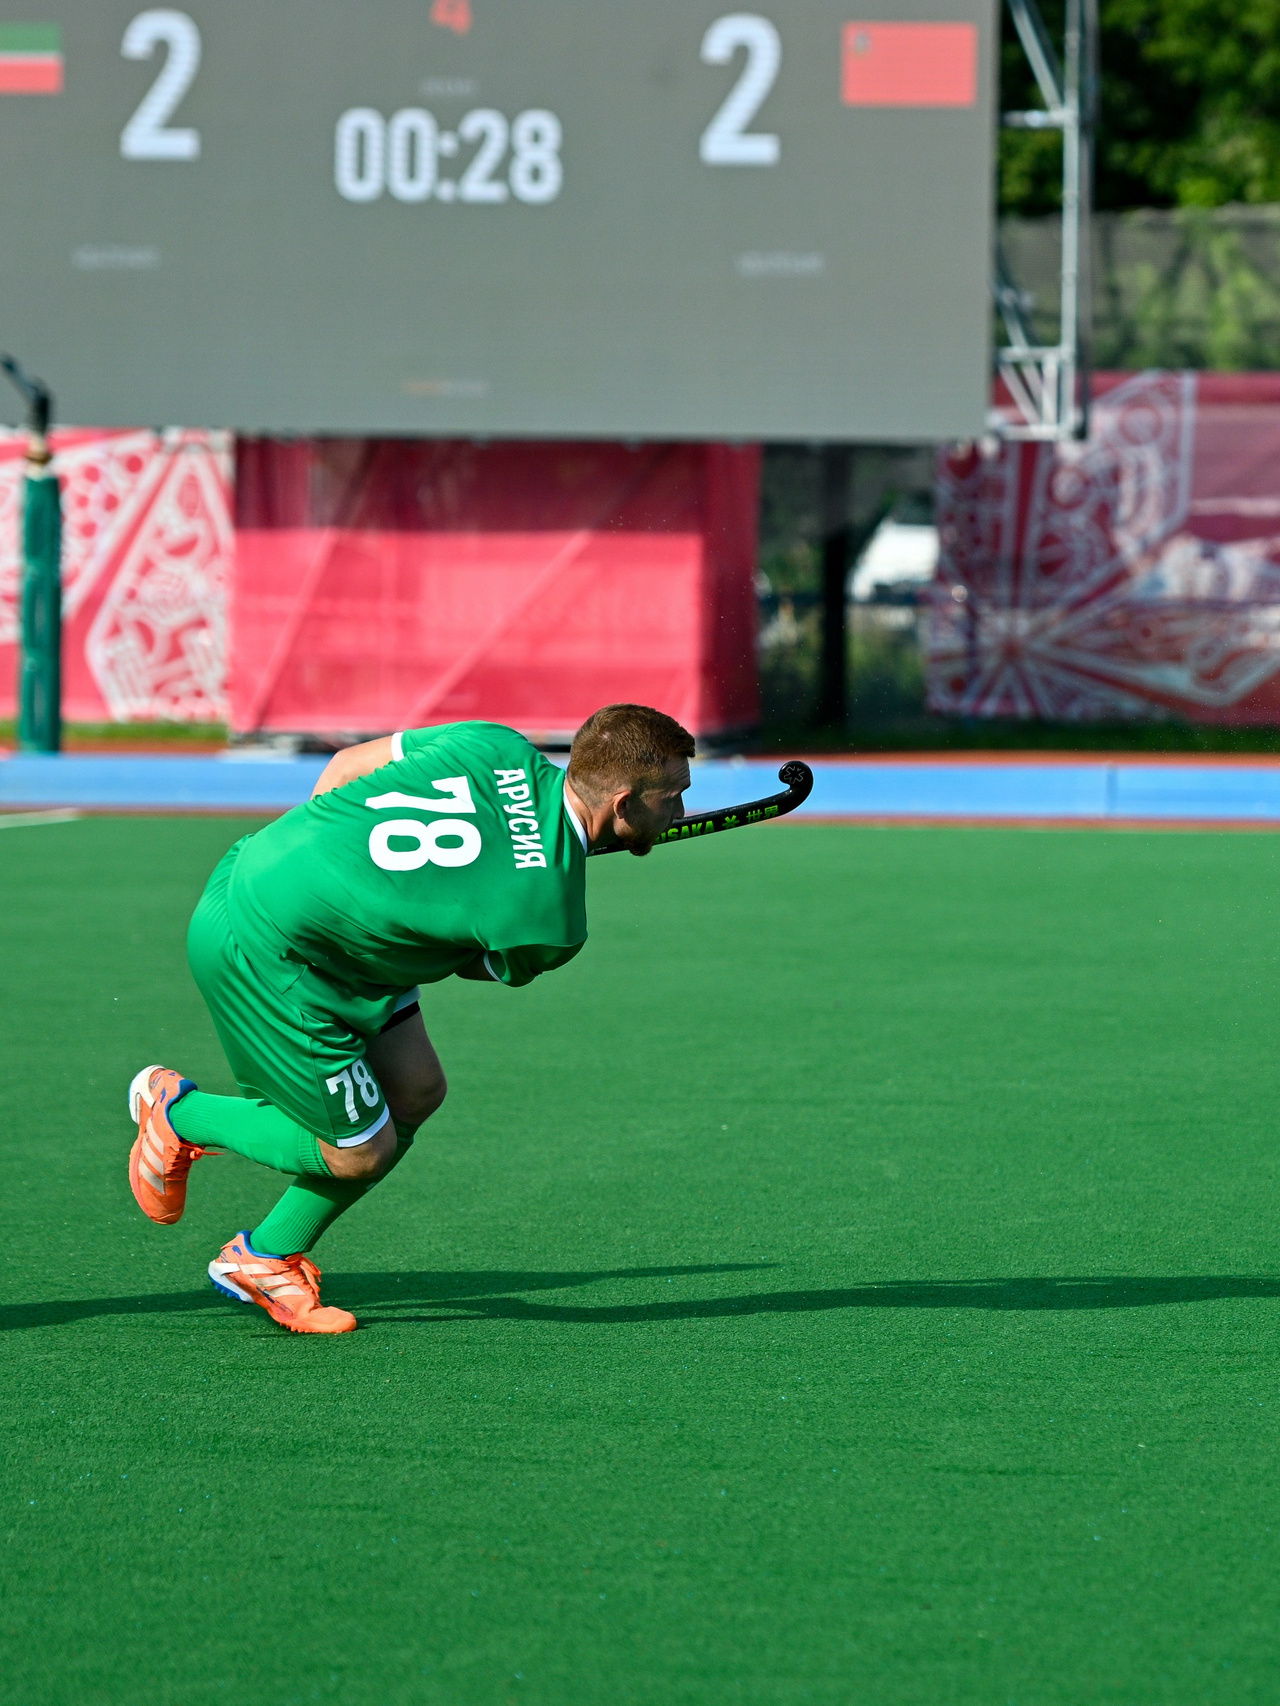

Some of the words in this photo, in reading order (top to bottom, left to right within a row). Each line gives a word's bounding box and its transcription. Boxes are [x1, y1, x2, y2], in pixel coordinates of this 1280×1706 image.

[120, 8, 202, 162] 2
[700, 13, 781, 166] 2
[334, 107, 563, 204] 00:28
[365, 775, 482, 872] 78
[493, 768, 547, 869] АРУСИЯ
[746, 805, 780, 824] 世界
[325, 1059, 379, 1123] 78
